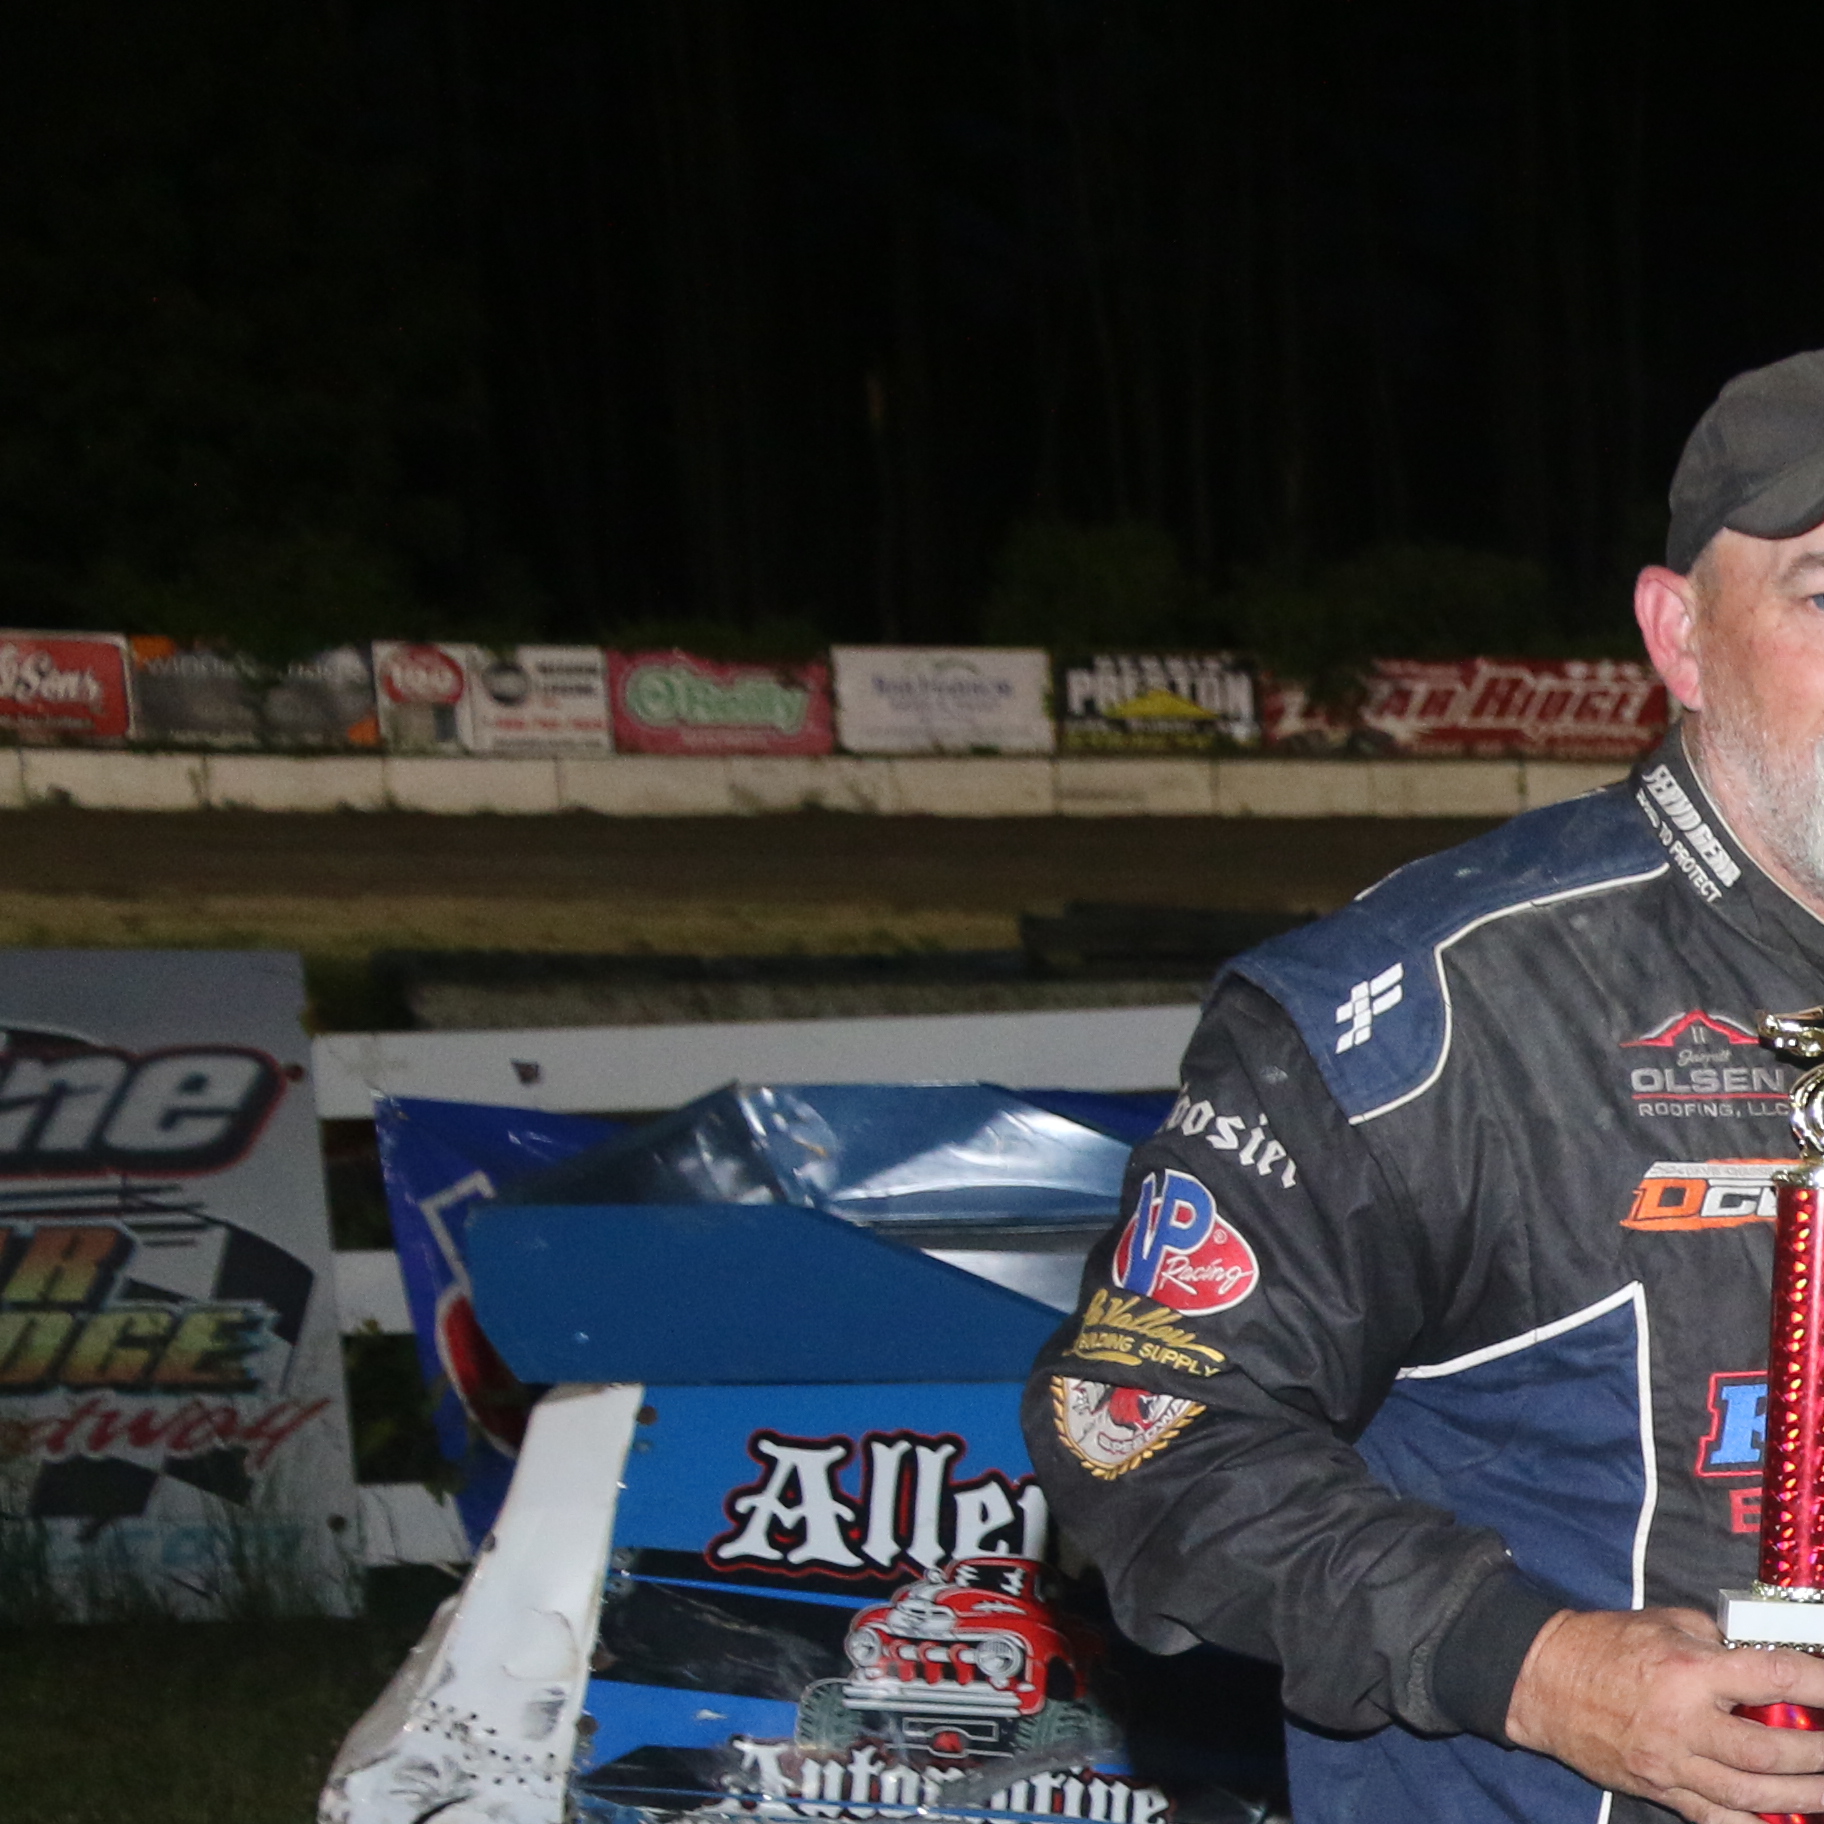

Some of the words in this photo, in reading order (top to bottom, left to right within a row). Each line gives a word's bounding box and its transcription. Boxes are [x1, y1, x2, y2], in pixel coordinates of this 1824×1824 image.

[1669, 840, 1722, 902] PROTECT
[1631, 1067, 1786, 1093] OLSEN
[1638, 1102, 1741, 1117] ROOFING,
[1749, 1102, 1790, 1116] LLC
[1159, 1256, 1253, 1295] Racing
[1138, 1341, 1222, 1378] SUPPLY
